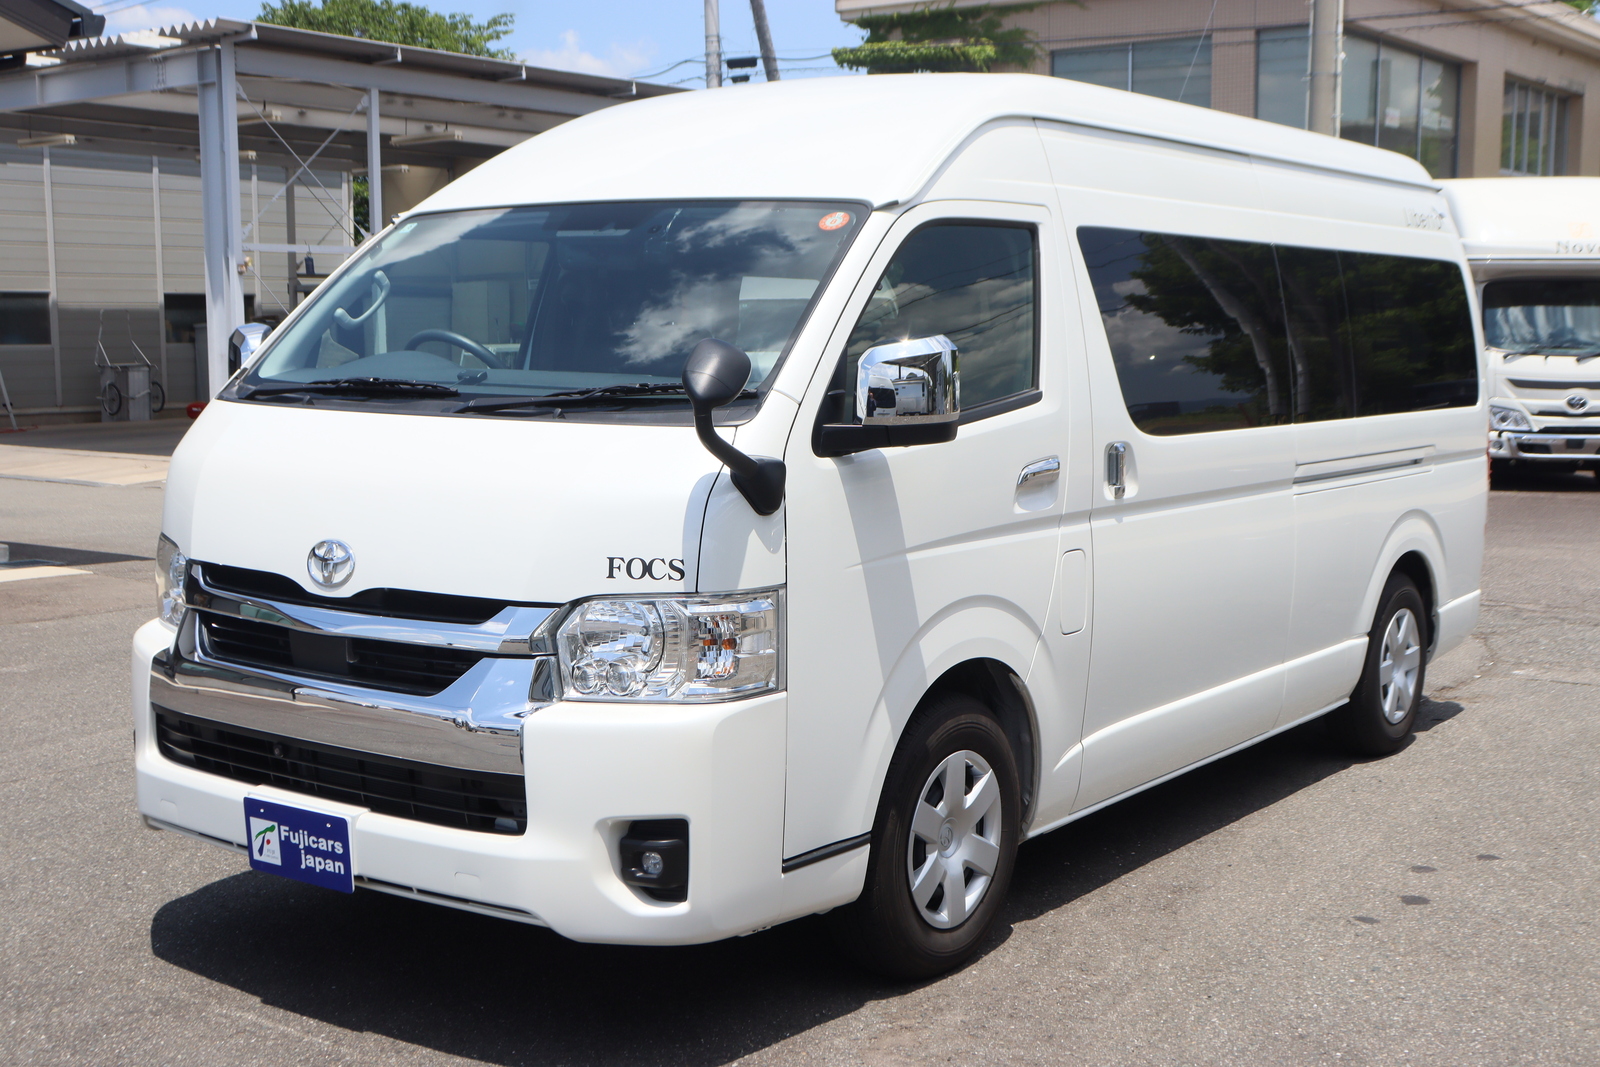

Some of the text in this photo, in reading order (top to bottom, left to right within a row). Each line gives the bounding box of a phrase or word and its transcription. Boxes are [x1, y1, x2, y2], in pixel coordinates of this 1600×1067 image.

[1555, 240, 1600, 254] Nov
[606, 556, 685, 581] FOCS
[280, 825, 343, 854] Fujicars
[300, 850, 344, 874] japan
